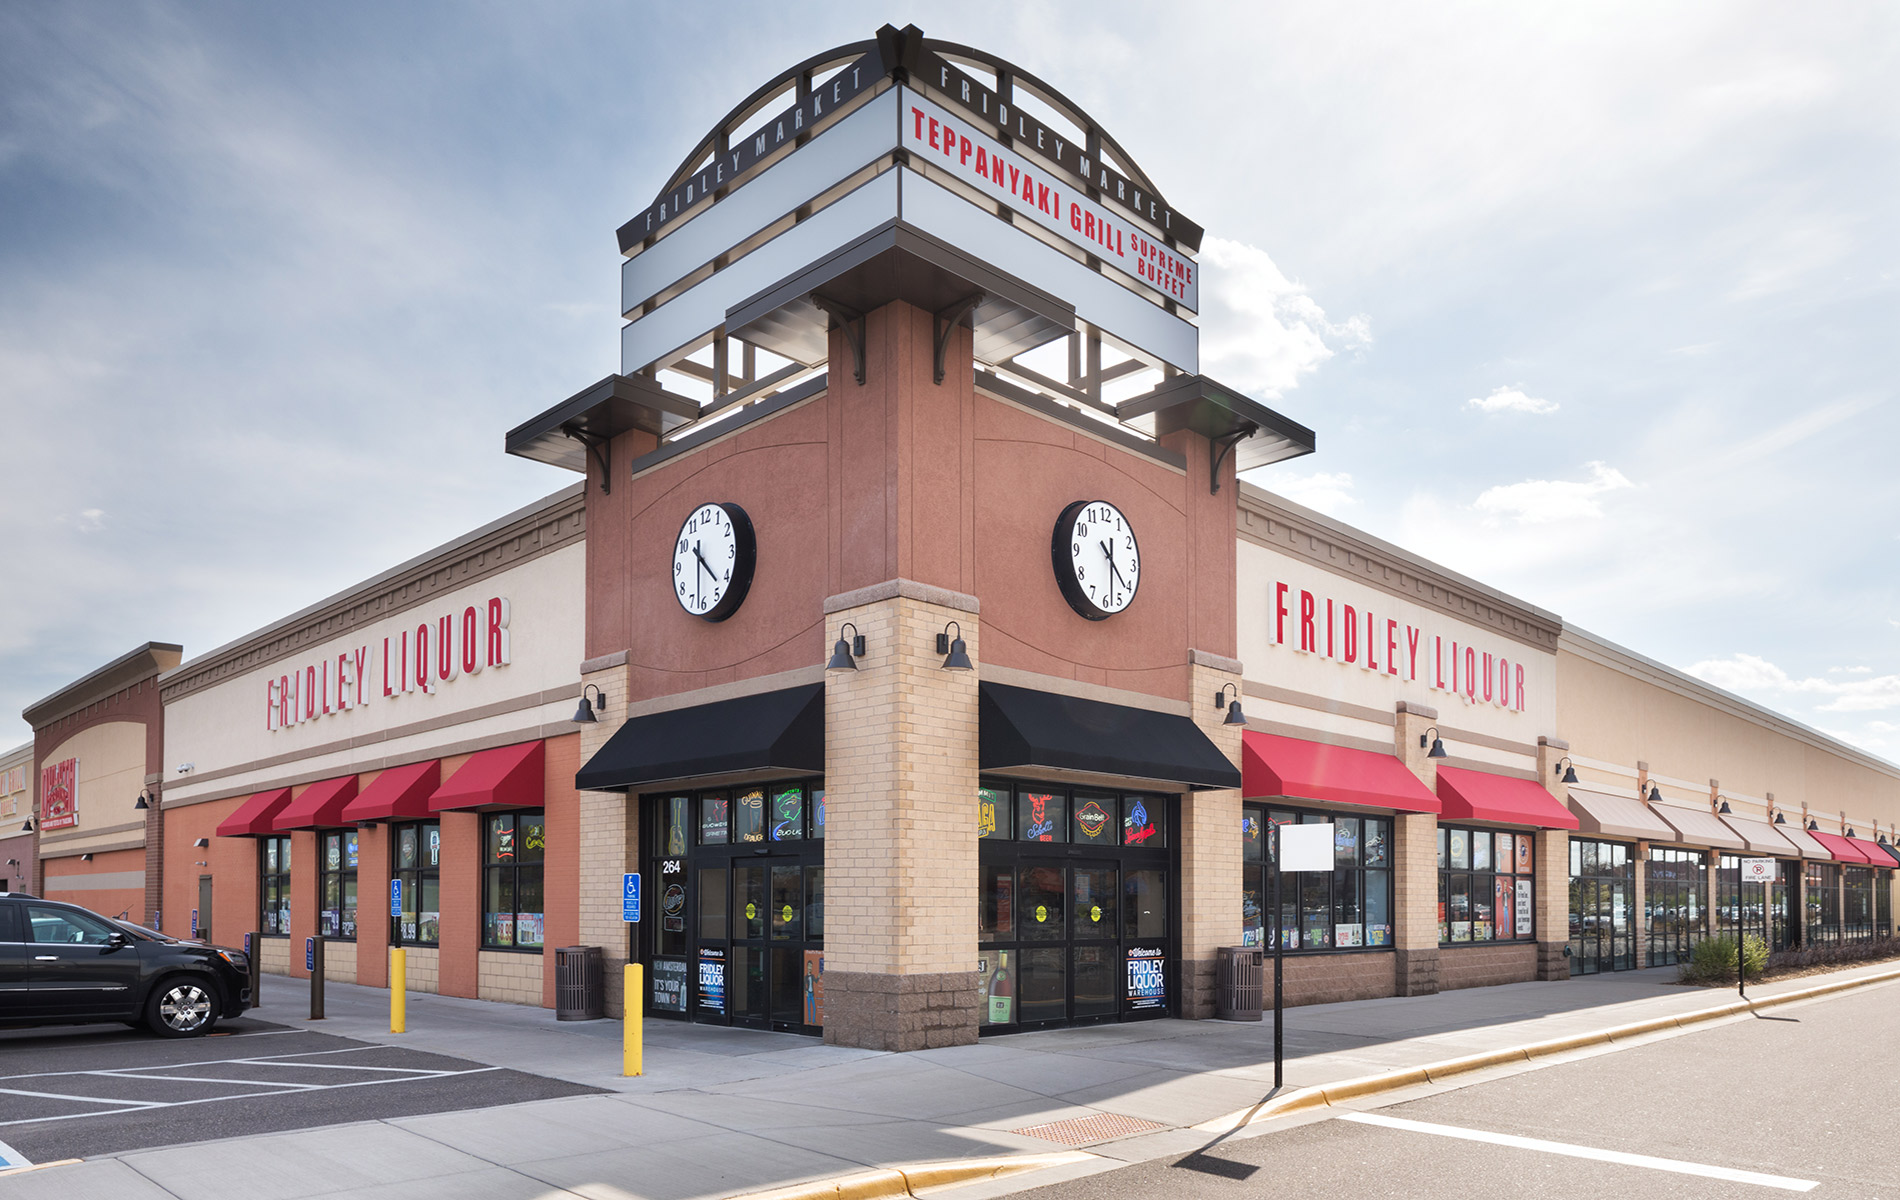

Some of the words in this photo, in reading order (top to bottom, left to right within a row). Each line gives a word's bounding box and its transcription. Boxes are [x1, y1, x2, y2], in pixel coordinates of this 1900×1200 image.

[646, 151, 741, 231] FRIDLEY
[755, 67, 861, 157] MARKET
[940, 66, 1064, 161] FRIDLEY
[1080, 155, 1172, 230] MARKET
[911, 106, 1060, 221] TEPPANYAKI
[1070, 202, 1125, 258] GRILL
[1130, 232, 1193, 286] SUPREME
[1137, 257, 1186, 300] BUFFET
[700, 508, 712, 525] 12
[715, 510, 721, 526] 1
[1086, 507, 1098, 524] 11
[1100, 506, 1112, 524] 12
[688, 518, 698, 535] 11
[723, 522, 731, 538] 2
[1076, 521, 1088, 538] 10
[1115, 517, 1122, 532] 1
[679, 538, 689, 555] 10
[1072, 542, 1080, 557] 9
[1125, 535, 1132, 550] 2
[728, 544, 735, 559] 3
[675, 561, 682, 577] 9
[1077, 565, 1085, 581] 8
[1130, 558, 1137, 573] 3
[723, 568, 730, 583] 4
[679, 581, 686, 596] 8
[713, 586, 720, 602] 5
[1089, 584, 1096, 600] 7
[1125, 579, 1132, 594] 4
[688, 593, 695, 609] 7
[700, 595, 707, 611] 6
[1102, 594, 1109, 609] 6
[1116, 592, 1123, 607] 5
[1269, 580, 1420, 682] FRIDLEY
[1429, 634, 1526, 713] LIQUOR
[266, 644, 373, 731] FRIDLEY
[383, 596, 511, 698] LIQUOR
[978, 801, 997, 832] AGA
[1039, 834, 1052, 843] BEER
[663, 860, 680, 874] 264
[699, 963, 725, 975] FRIDLEY
[1127, 959, 1165, 975] FRIDLEY
[665, 980, 680, 992] YOUR
[699, 974, 724, 986] LIQUOR
[1127, 973, 1164, 990] LIQUOR
[654, 991, 671, 1004] TOWN
[1128, 987, 1165, 997] WAREHOUSE
